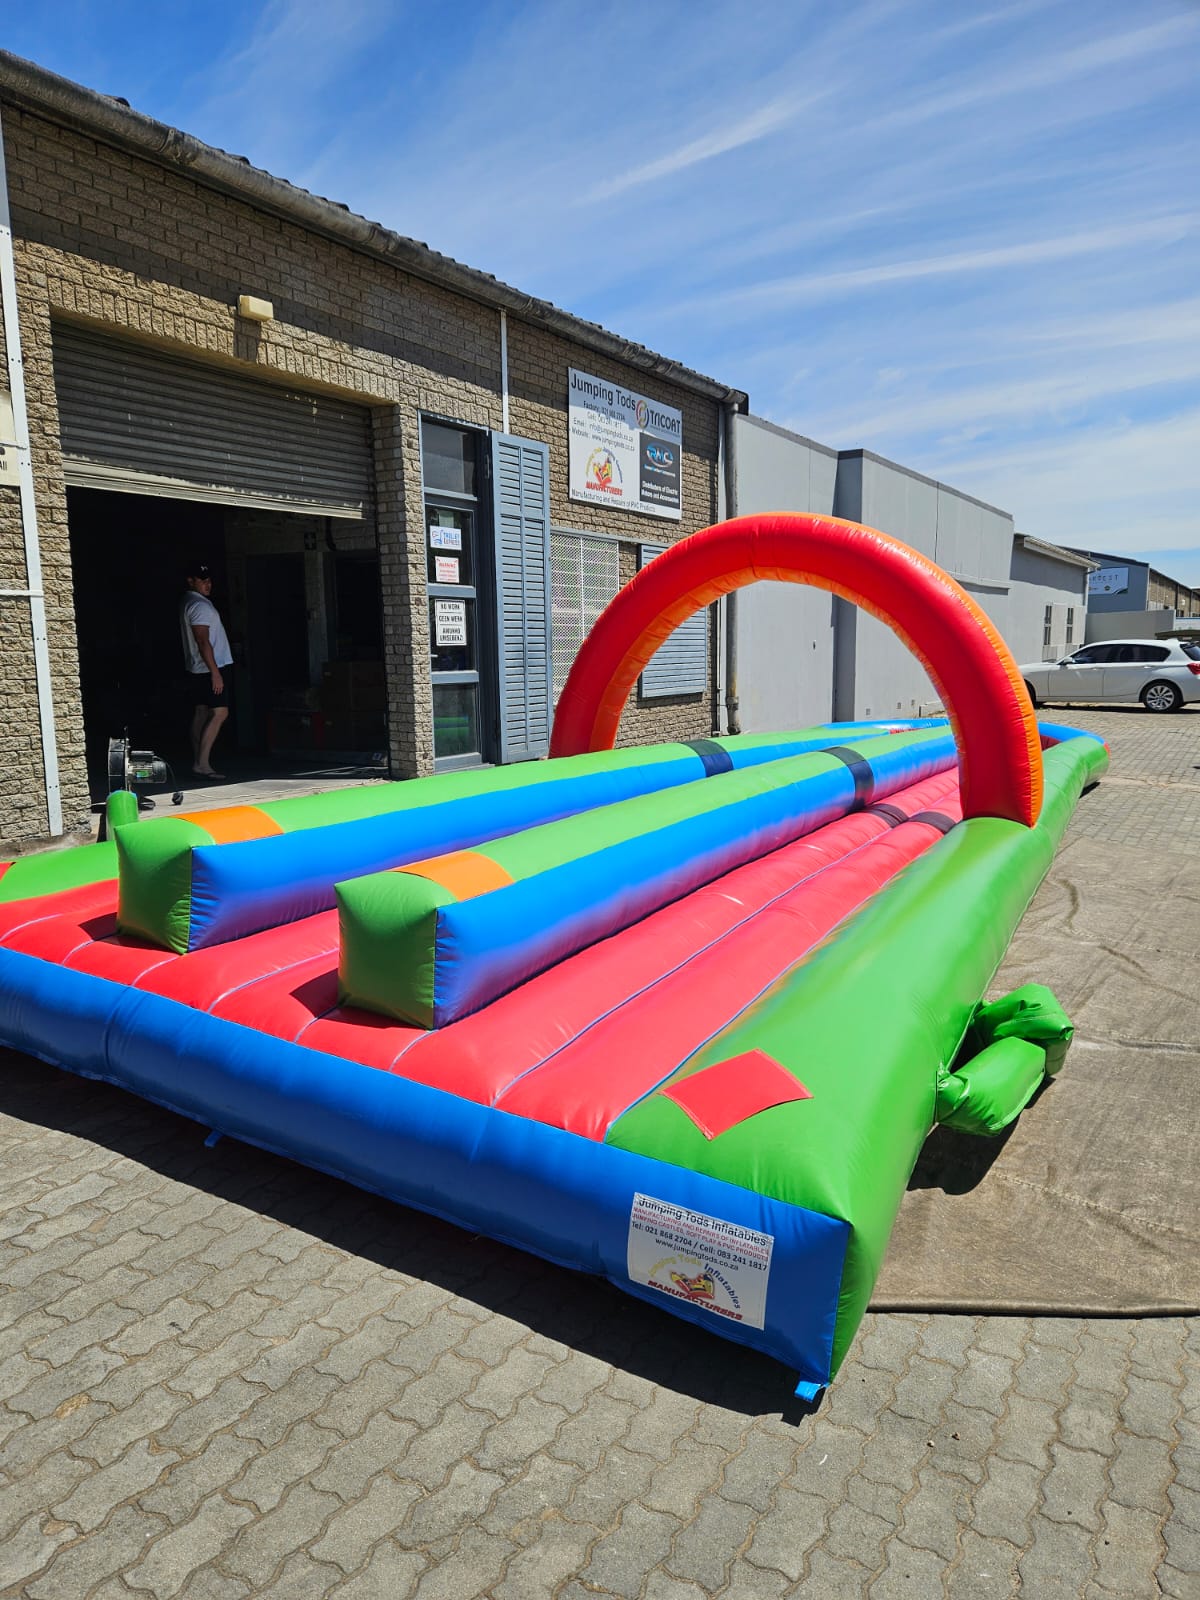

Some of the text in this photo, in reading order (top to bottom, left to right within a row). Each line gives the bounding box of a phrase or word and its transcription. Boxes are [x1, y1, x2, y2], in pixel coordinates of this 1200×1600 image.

[571, 374, 636, 411] Jumping Tods
[650, 409, 681, 433] TRICOAT
[632, 1213, 658, 1225] JUMPING
[685, 1230, 700, 1240] SOFT
[701, 1234, 716, 1244] PLAY
[722, 1242, 735, 1251] PVC
[735, 1246, 769, 1262] PRODUCTS
[633, 1207, 769, 1255] MANUFACTURING AND REPAIRS OF INFLATABLES
[639, 1198, 767, 1246] Jumping Tods Inflatables
[632, 1220, 644, 1231] Tel:
[644, 1225, 658, 1236] 021
[674, 1234, 692, 1247] 2704
[692, 1241, 699, 1249] /
[699, 1243, 716, 1256] Cell:
[716, 1249, 731, 1260] 083
[732, 1254, 747, 1265] 241
[748, 1260, 768, 1272] 1817
[655, 1238, 739, 1271] www.jumpingtods.co.za
[647, 1280, 743, 1321] MANUFACTURERS
[703, 1263, 741, 1309] Inflatables
